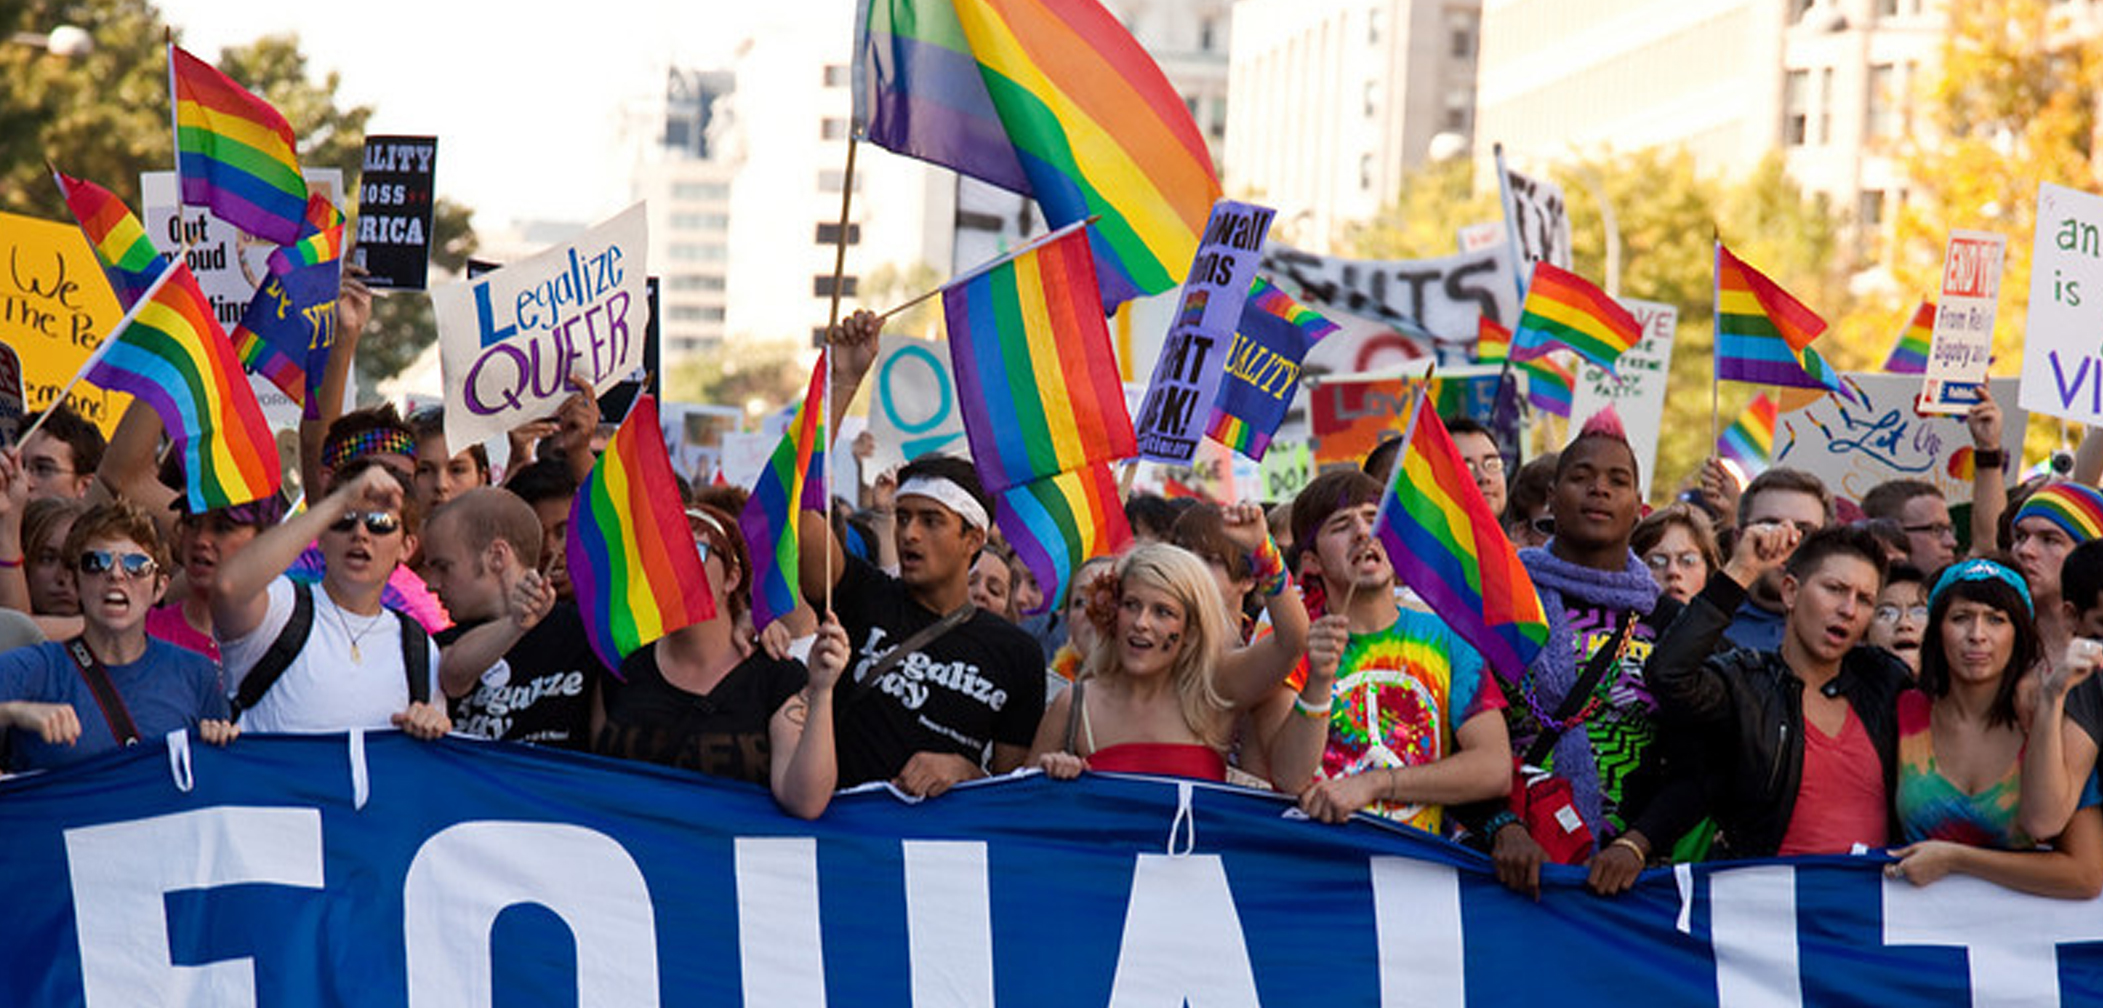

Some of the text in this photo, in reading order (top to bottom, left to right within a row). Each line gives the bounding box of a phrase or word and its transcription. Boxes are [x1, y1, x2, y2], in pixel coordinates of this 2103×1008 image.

[168, 214, 208, 243] Out
[11, 245, 82, 311] We
[473, 245, 624, 349] Legalize
[2055, 270, 2081, 306] is
[464, 291, 630, 416] QUEER
[1632, 306, 1672, 338] VE
[1224, 332, 1300, 400] UALITY
[1828, 410, 1932, 472] Let
